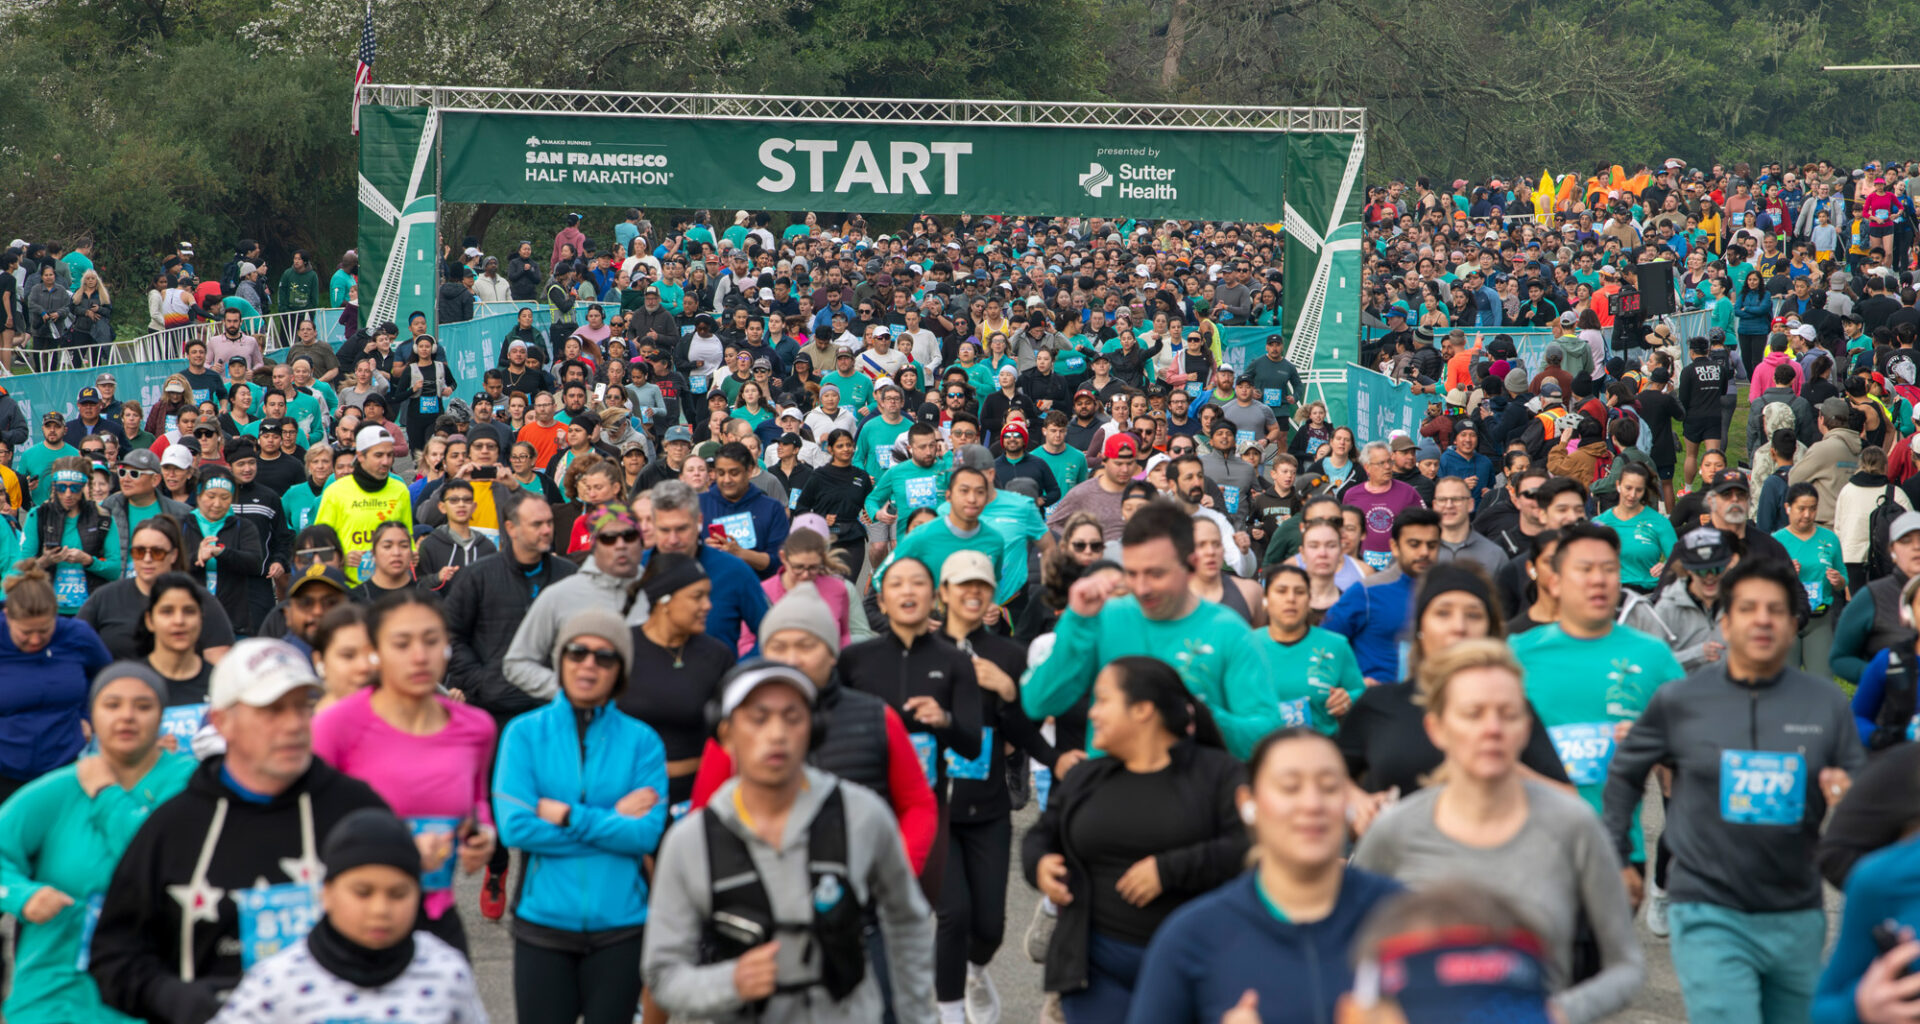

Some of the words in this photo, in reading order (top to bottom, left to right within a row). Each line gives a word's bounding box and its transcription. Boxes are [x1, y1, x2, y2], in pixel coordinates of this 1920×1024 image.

[526, 151, 564, 165] SAN
[567, 154, 668, 168] FRANCISCO
[1097, 147, 1146, 157] presented
[1148, 147, 1160, 158] by
[757, 137, 973, 195] START
[1119, 163, 1176, 180] Sutter
[526, 168, 568, 182] HALF
[1119, 183, 1177, 200] Health
[1760, 262, 1776, 276] Cal
[1695, 365, 1721, 375] RUSH
[1698, 372, 1721, 381] CLUB
[142, 384, 163, 406] SA
[351, 499, 388, 509] Achilles
[351, 531, 375, 545] GU
[728, 526, 751, 538] 606
[1366, 557, 1389, 566] 7024
[59, 583, 86, 593] 7735
[1285, 711, 1304, 728] 23
[162, 719, 198, 736] 743
[1557, 737, 1611, 761] 7657
[1731, 769, 1796, 796] 7879
[256, 907, 317, 939] 812
